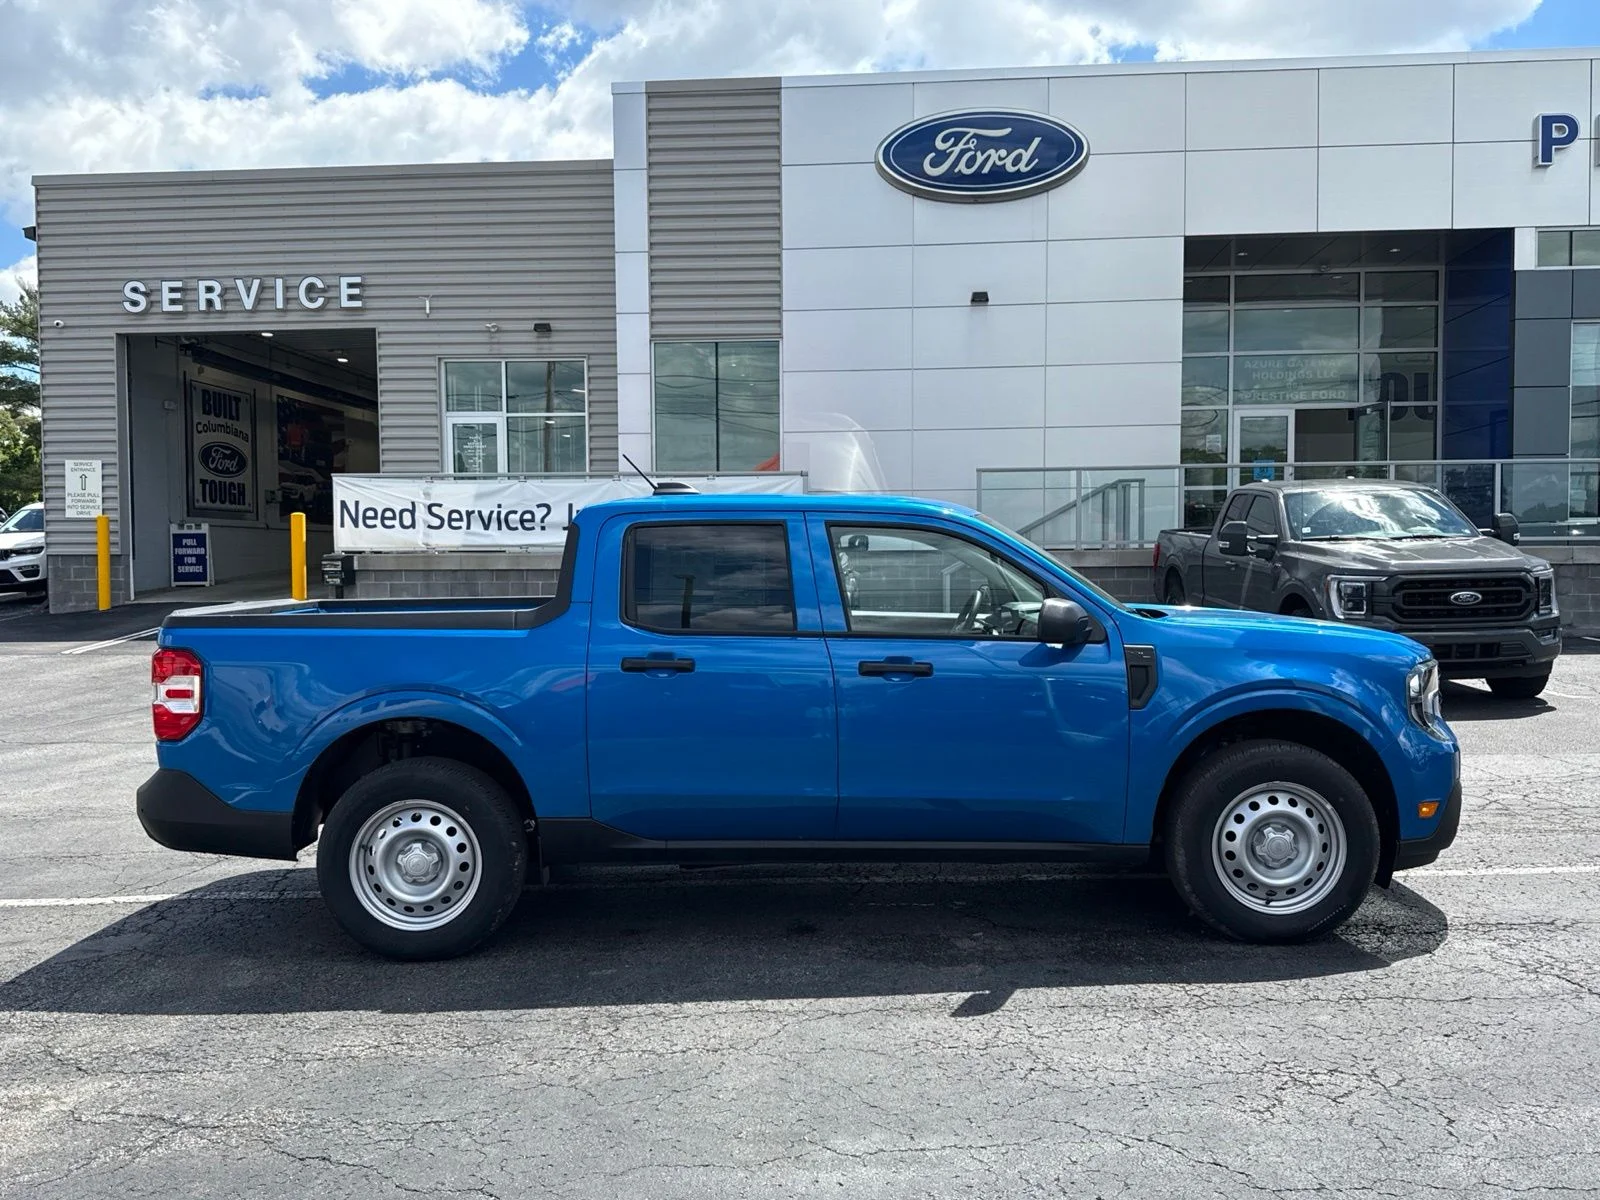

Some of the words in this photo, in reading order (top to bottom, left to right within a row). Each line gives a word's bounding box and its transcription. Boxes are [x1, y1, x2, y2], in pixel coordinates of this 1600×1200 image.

[922, 127, 1042, 177] Ford
[122, 275, 365, 313] SERVICE
[1244, 359, 1283, 369] AZURE
[1252, 371, 1313, 380] HOLDINGS
[1316, 369, 1338, 379] LLC
[1244, 390, 1308, 400] PRESTIGE
[1311, 390, 1346, 399] FORD
[202, 390, 241, 421] BUILT
[196, 420, 249, 444] Columbiana
[208, 446, 239, 472] Ford
[199, 478, 246, 506] TOUGH
[339, 499, 417, 530] Need
[427, 502, 551, 532] Service?
[562, 503, 580, 531] J
[182, 538, 197, 546] PULL
[174, 547, 205, 555] FORWARD
[184, 556, 197, 564] FOR
[177, 565, 203, 573] SERVICE
